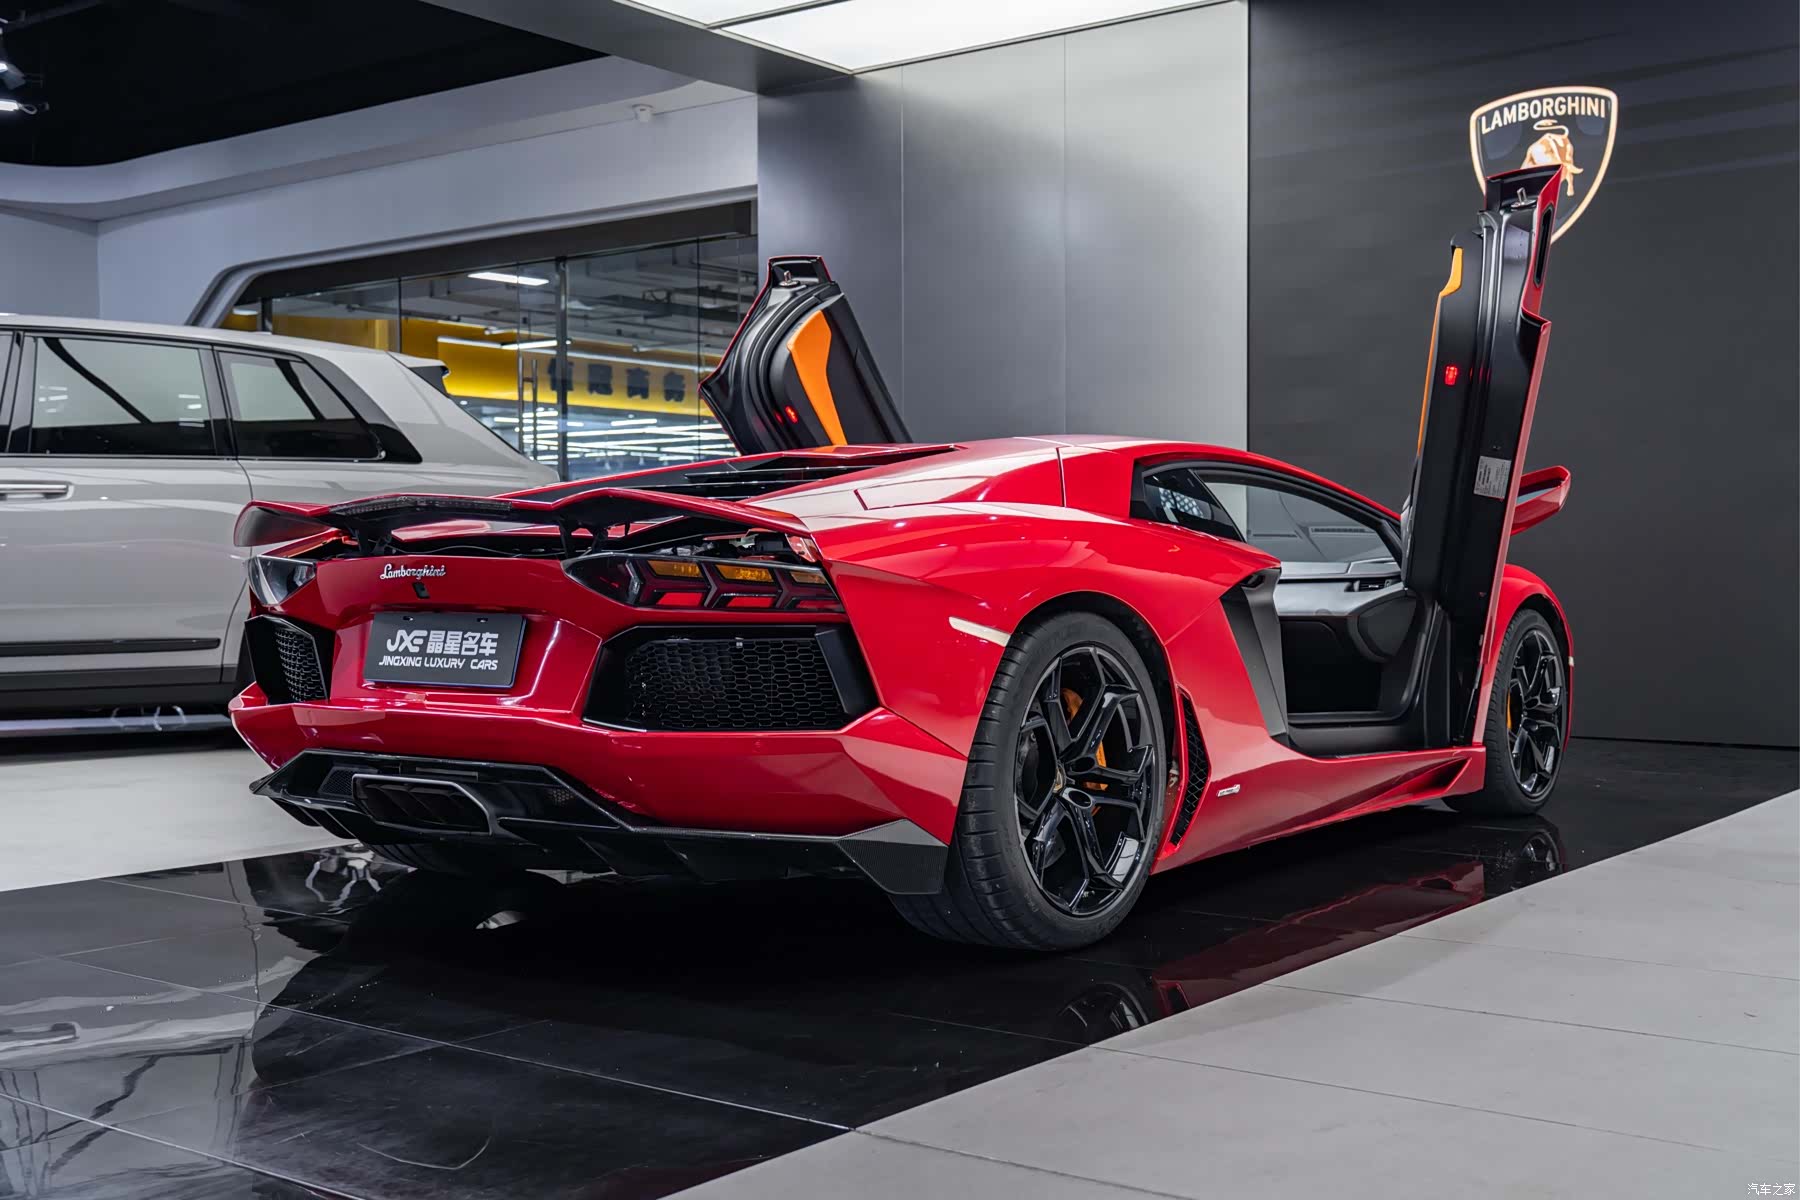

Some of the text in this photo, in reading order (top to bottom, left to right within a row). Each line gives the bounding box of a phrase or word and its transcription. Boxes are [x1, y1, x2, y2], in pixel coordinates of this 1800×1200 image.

[1481, 96, 1605, 135] LAMBORGHINI
[380, 564, 446, 580] Lamborghini
[426, 630, 499, 656] 晶星名车
[378, 656, 498, 671] JINGXING LUXURY CARS
